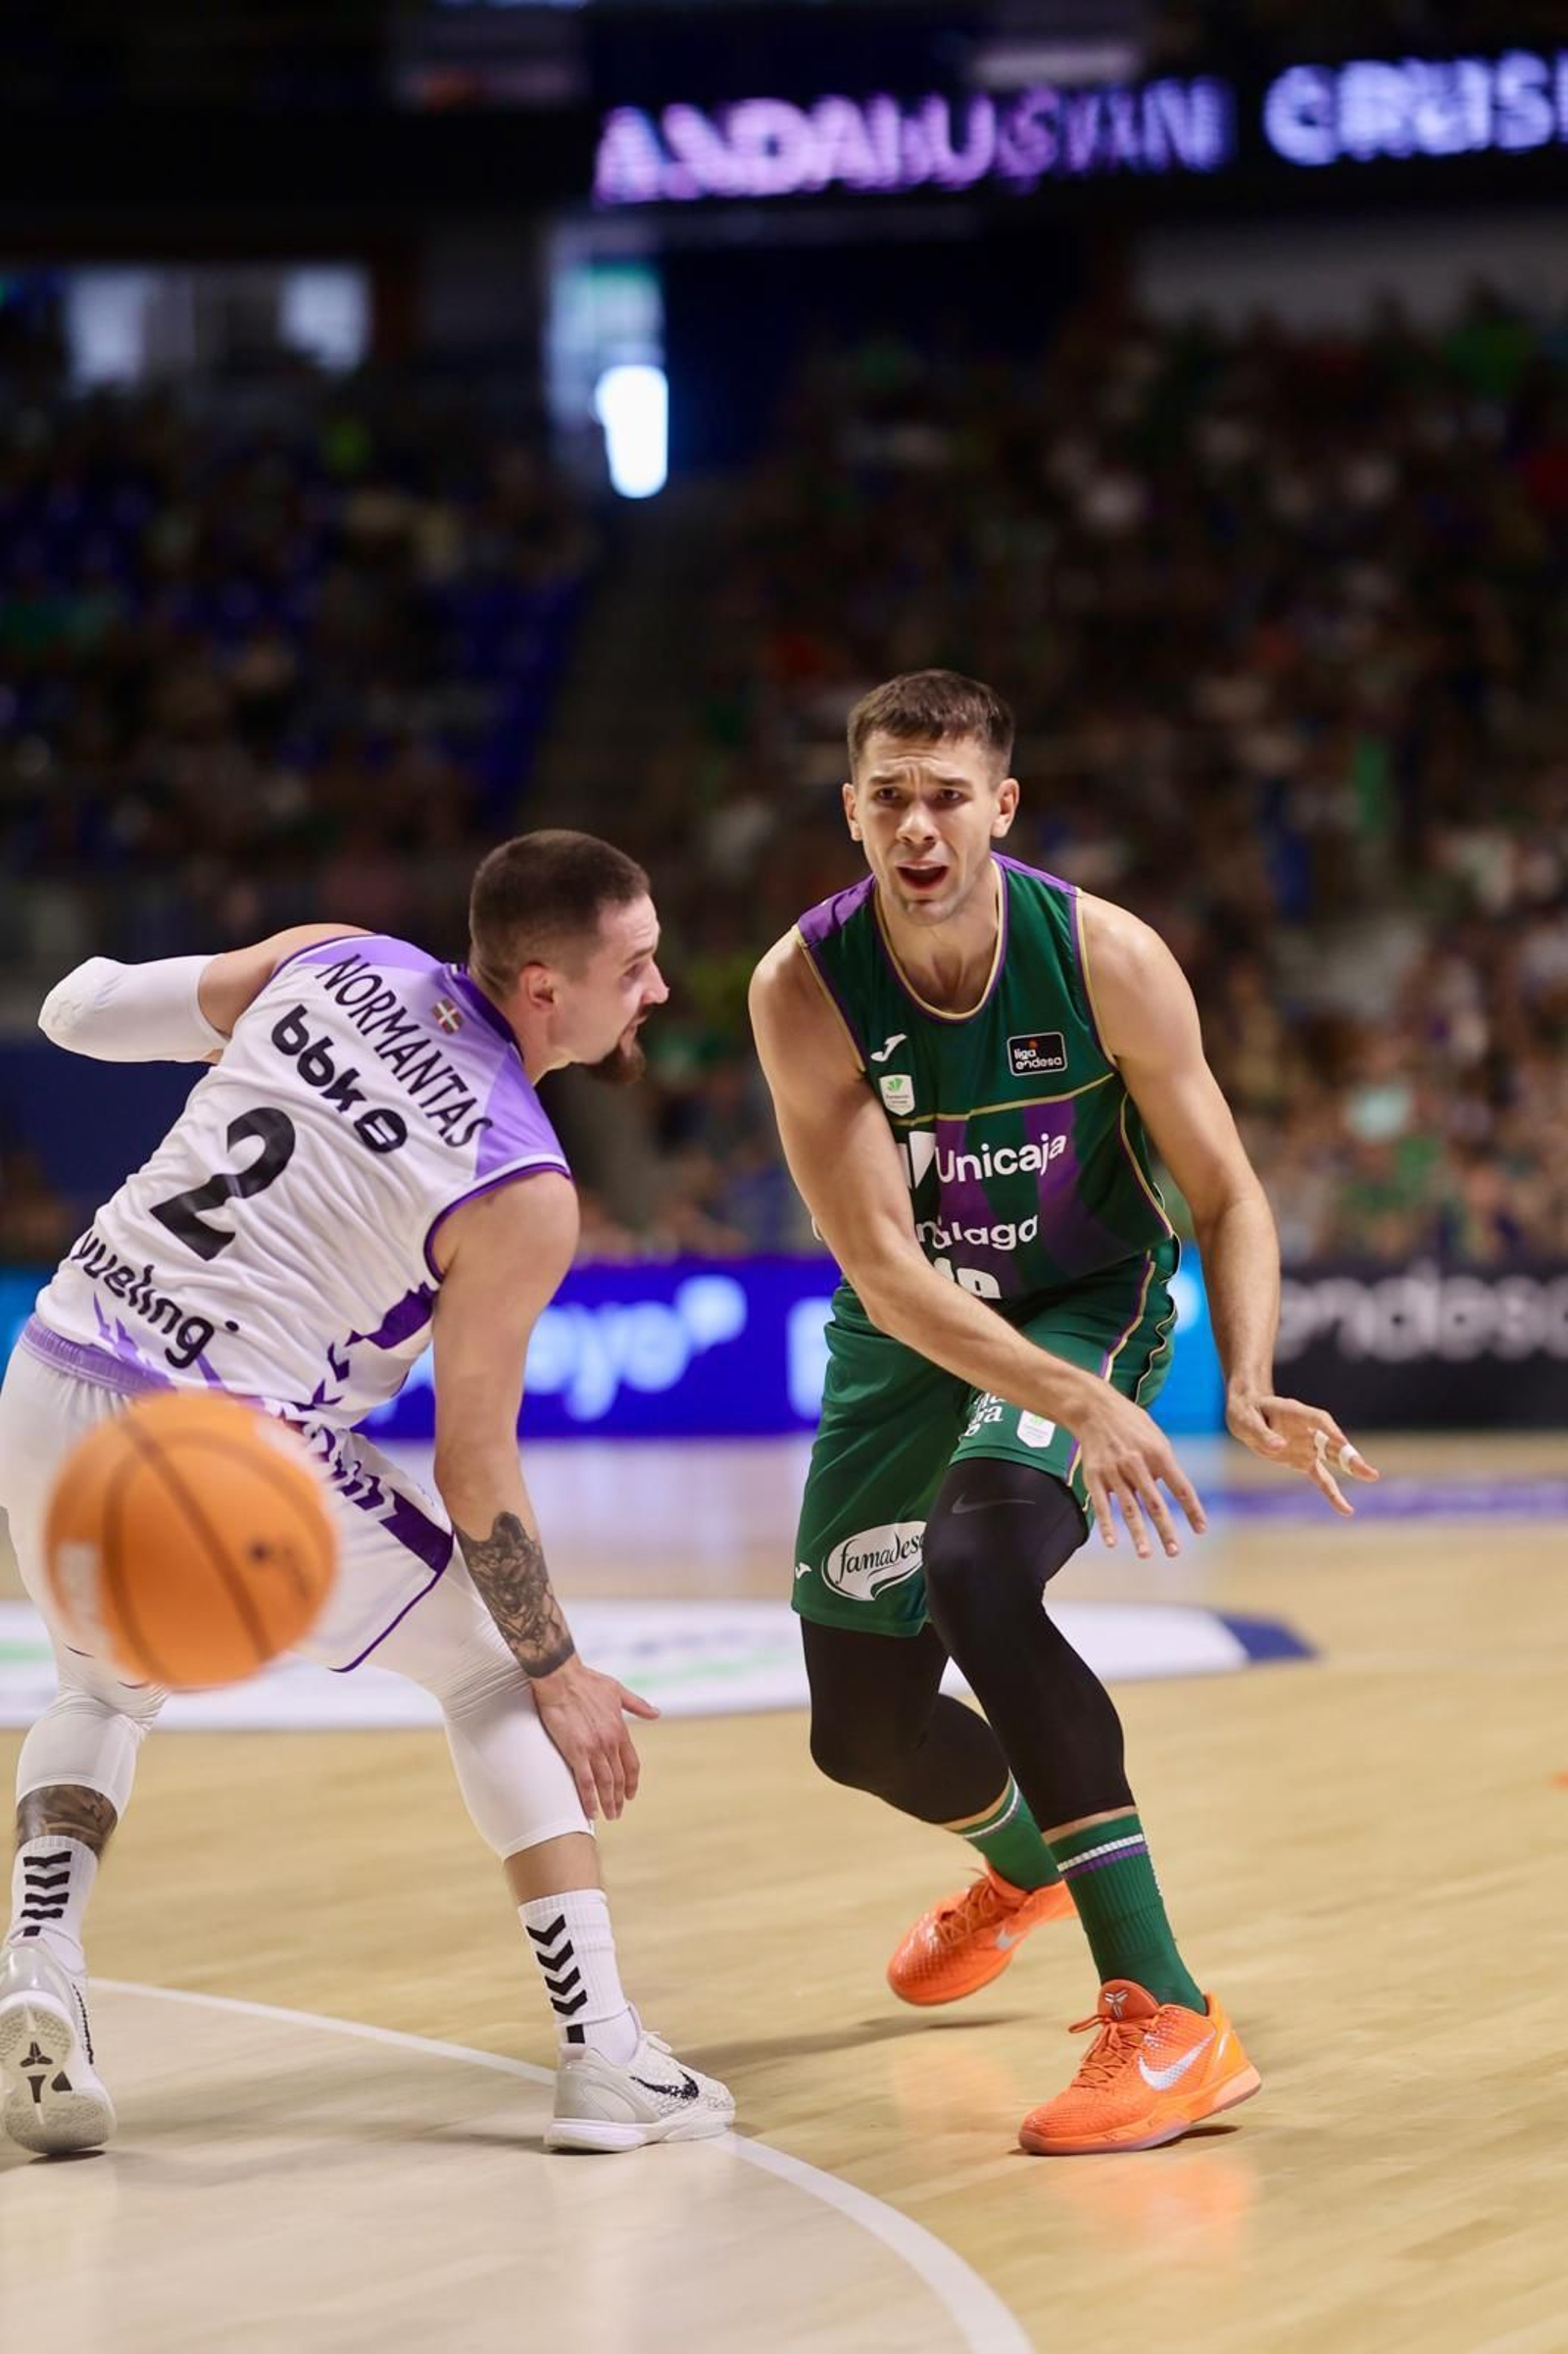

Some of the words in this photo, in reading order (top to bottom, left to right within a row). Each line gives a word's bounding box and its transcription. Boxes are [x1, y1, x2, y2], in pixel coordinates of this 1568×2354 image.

[1264, 49, 1568, 165] CRUIS
[315, 954, 493, 1148] NORMANTAS
[1013, 1048, 1037, 1060] liga
[1015, 1057, 1062, 1070] endesa
[150, 1106, 296, 1261] 2
[935, 1133, 1067, 1183] Unicaja
[834, 1532, 925, 1585] famades
